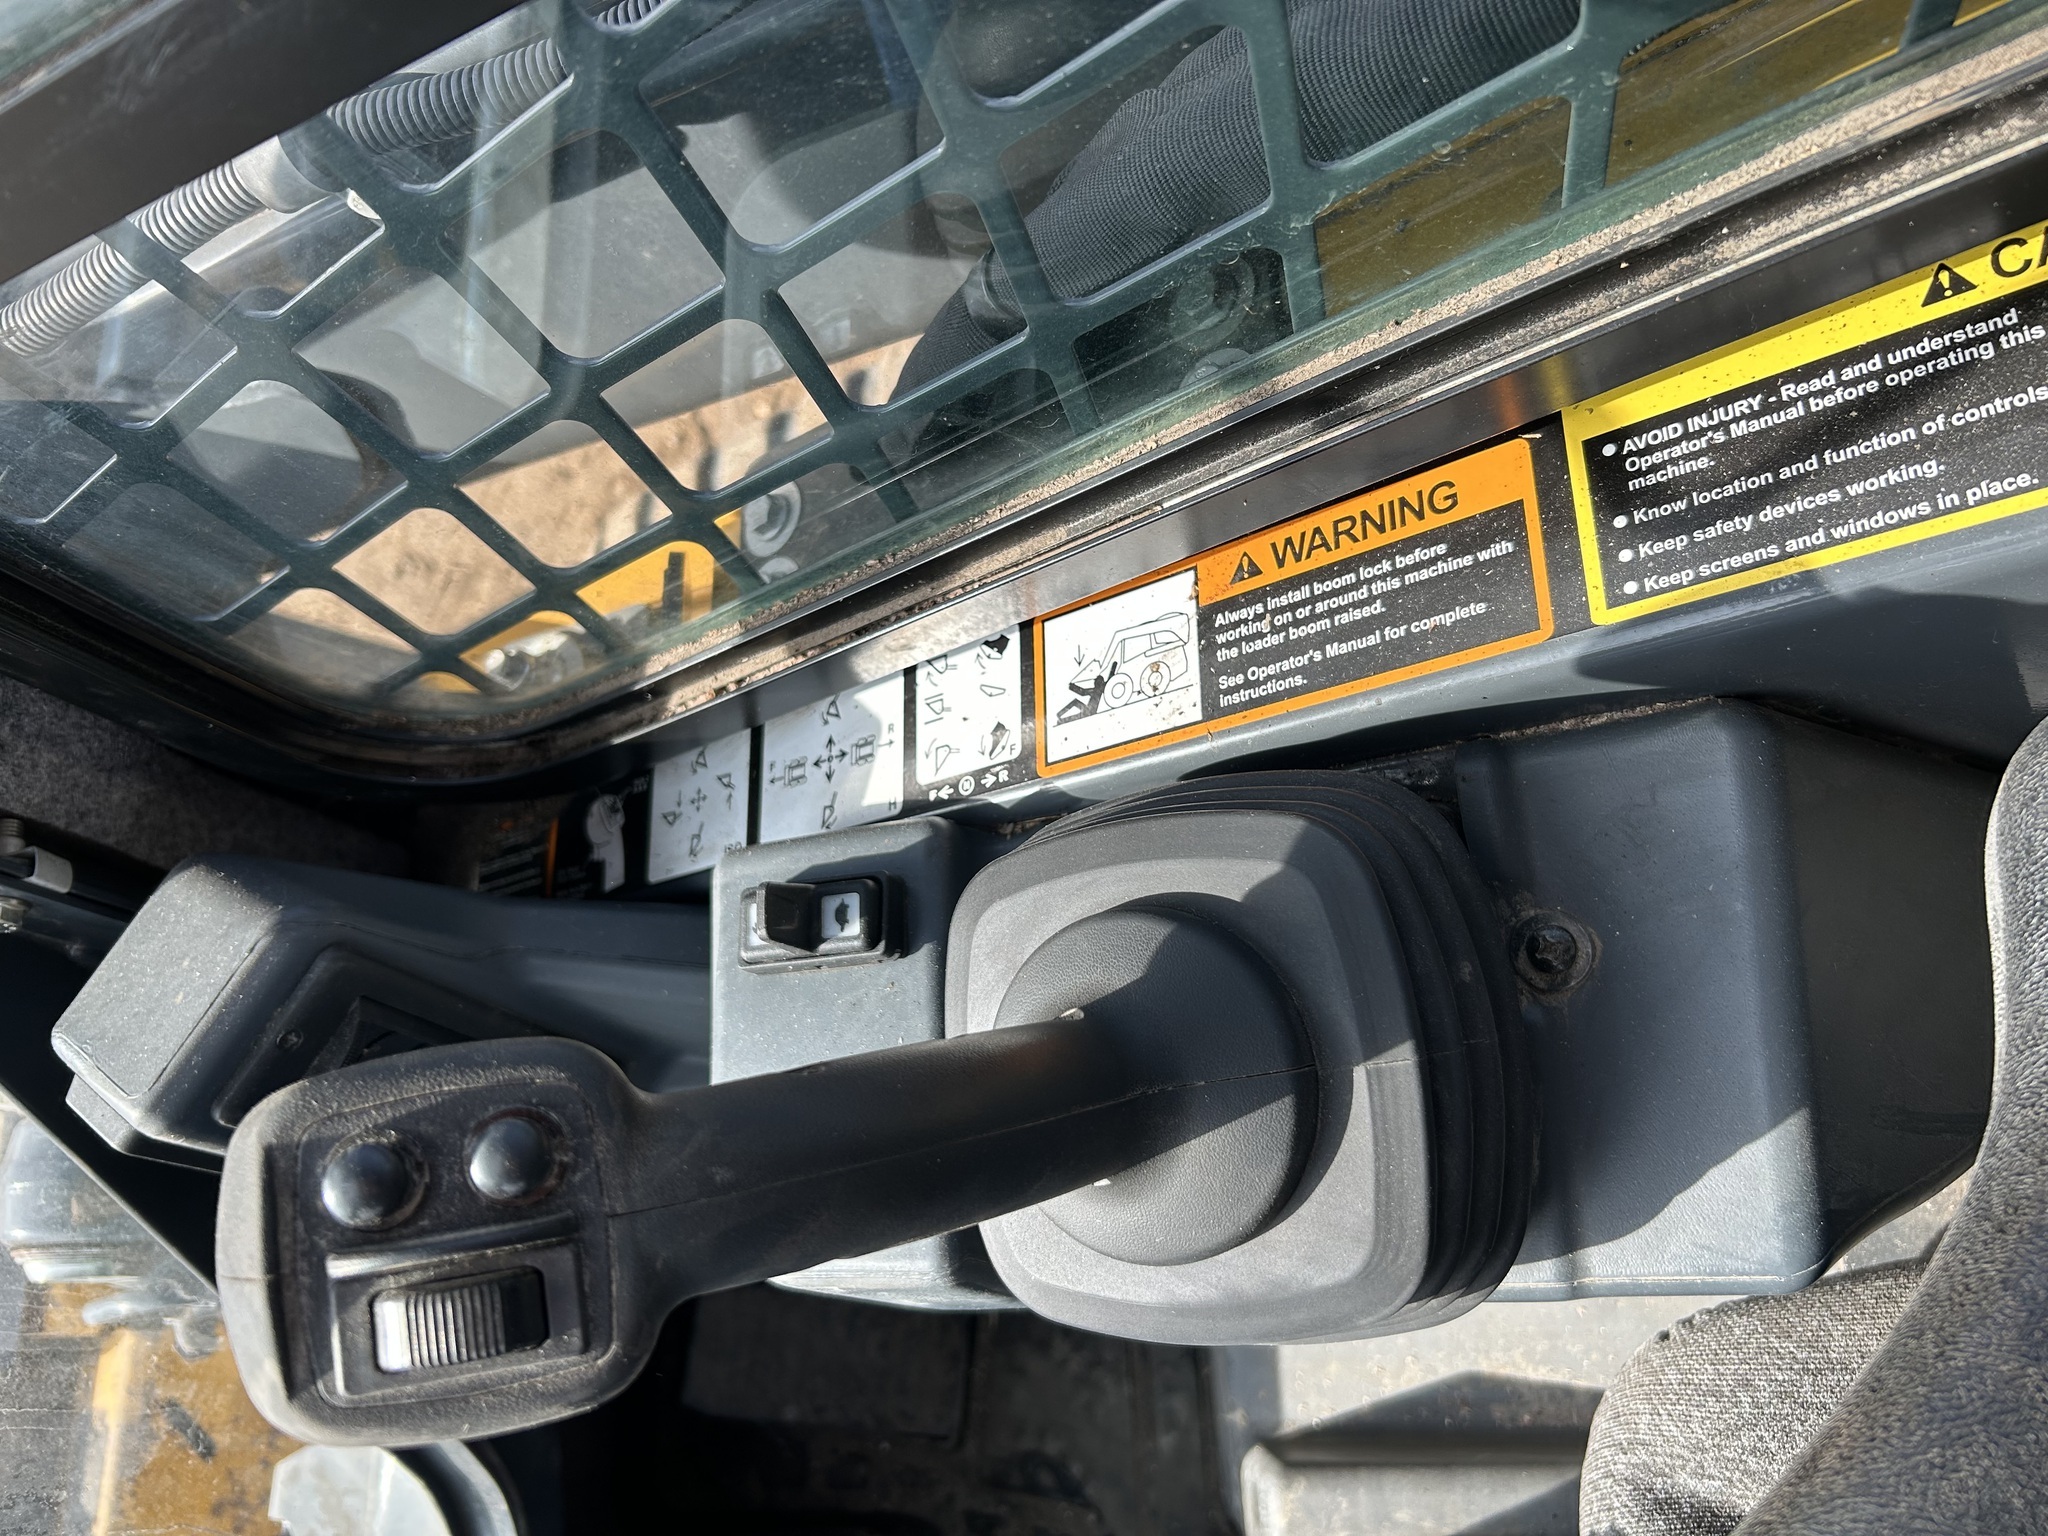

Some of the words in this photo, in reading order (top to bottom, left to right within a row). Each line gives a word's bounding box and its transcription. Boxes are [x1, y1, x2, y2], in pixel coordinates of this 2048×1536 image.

[1991, 226, 2048, 278] C
[1622, 422, 1684, 454] AVOID
[1687, 394, 1762, 432] INJURY
[1780, 370, 1836, 401] Read
[1840, 354, 1882, 381] and
[1887, 308, 2019, 365] understand
[1625, 431, 1727, 472] Operator's
[1730, 401, 1805, 438] Manual
[1810, 380, 1879, 412] before
[1885, 340, 1995, 387] operating
[2000, 324, 2046, 349] this
[1628, 455, 1715, 491] machine.
[1633, 497, 1687, 524] Know
[1693, 472, 1773, 506] location
[1779, 454, 1819, 480] and
[1823, 427, 1917, 465] function
[1922, 413, 1946, 435] of
[1951, 386, 2048, 426] controls
[1270, 480, 1459, 570] WARNING
[1639, 534, 1688, 558] Keep
[1693, 514, 1753, 542] safety
[1759, 488, 1842, 522] devices
[1846, 459, 1945, 497] working.
[1643, 568, 1694, 592] Keep
[1699, 544, 1780, 577] screens
[1785, 528, 1825, 552] and
[1830, 501, 1931, 540] windows
[1937, 488, 1960, 510] in
[1966, 472, 2039, 505] place.
[1215, 601, 1264, 627] Always
[1267, 584, 1311, 610] install
[1313, 572, 1356, 595] boom
[1359, 559, 1393, 580] lock
[1395, 542, 1448, 569] before
[1215, 619, 1271, 644] working
[1274, 612, 1292, 626] on
[1296, 605, 1312, 619] or
[1315, 585, 1370, 613] around
[1371, 577, 1402, 596] this
[1405, 554, 1474, 585] machine
[1477, 540, 1514, 562] with
[1216, 646, 1238, 662] the
[1242, 631, 1286, 653] loader
[1289, 618, 1330, 640] boom
[1334, 600, 1386, 627] raised.
[1218, 673, 1245, 689] See
[1248, 649, 1323, 681] Operator's
[1325, 630, 1380, 658] Manual
[1384, 624, 1408, 641] for
[1411, 601, 1488, 633] complete
[1219, 674, 1308, 707] instructions.
[999, 770, 1009, 782] R
[1010, 744, 1016, 755] F
[889, 797, 896, 811] H
